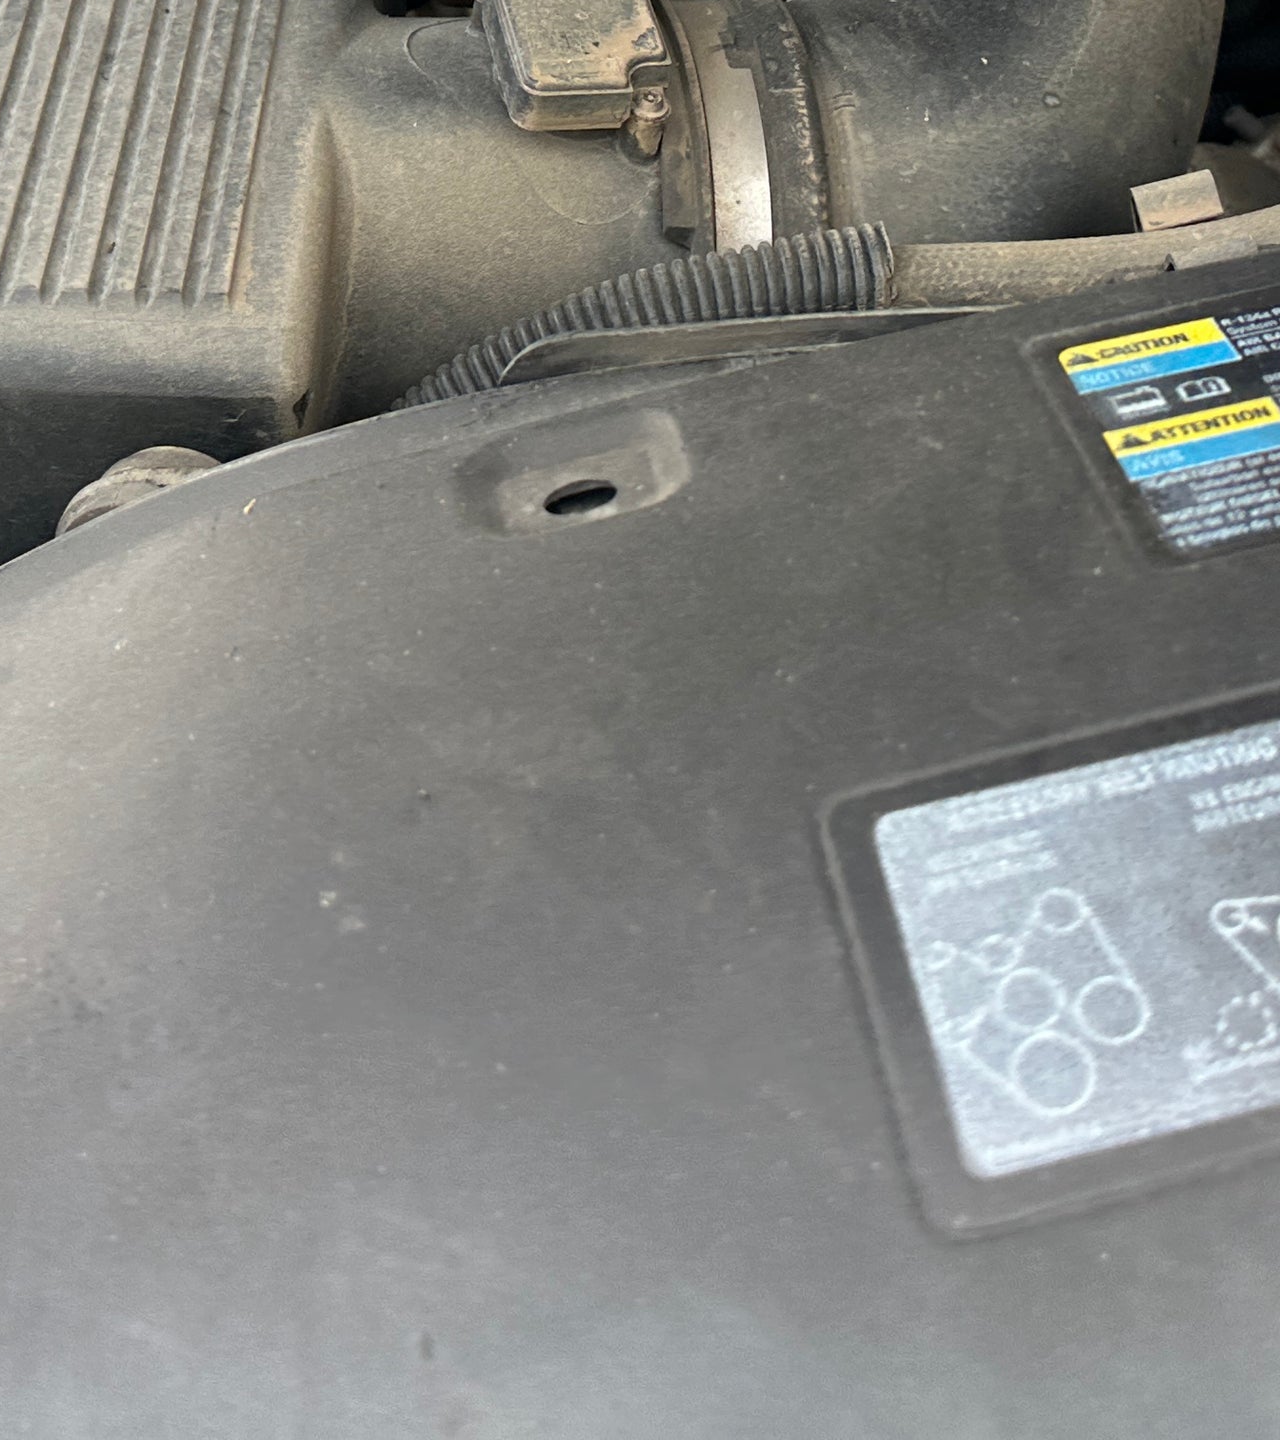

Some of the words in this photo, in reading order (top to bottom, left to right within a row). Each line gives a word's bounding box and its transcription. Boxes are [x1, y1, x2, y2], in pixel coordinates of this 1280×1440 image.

[1099, 334, 1188, 357] CAUTION
[1079, 362, 1156, 386] NOTICE
[1148, 408, 1271, 441] ATTENTION
[1131, 452, 1185, 470] AVIS
